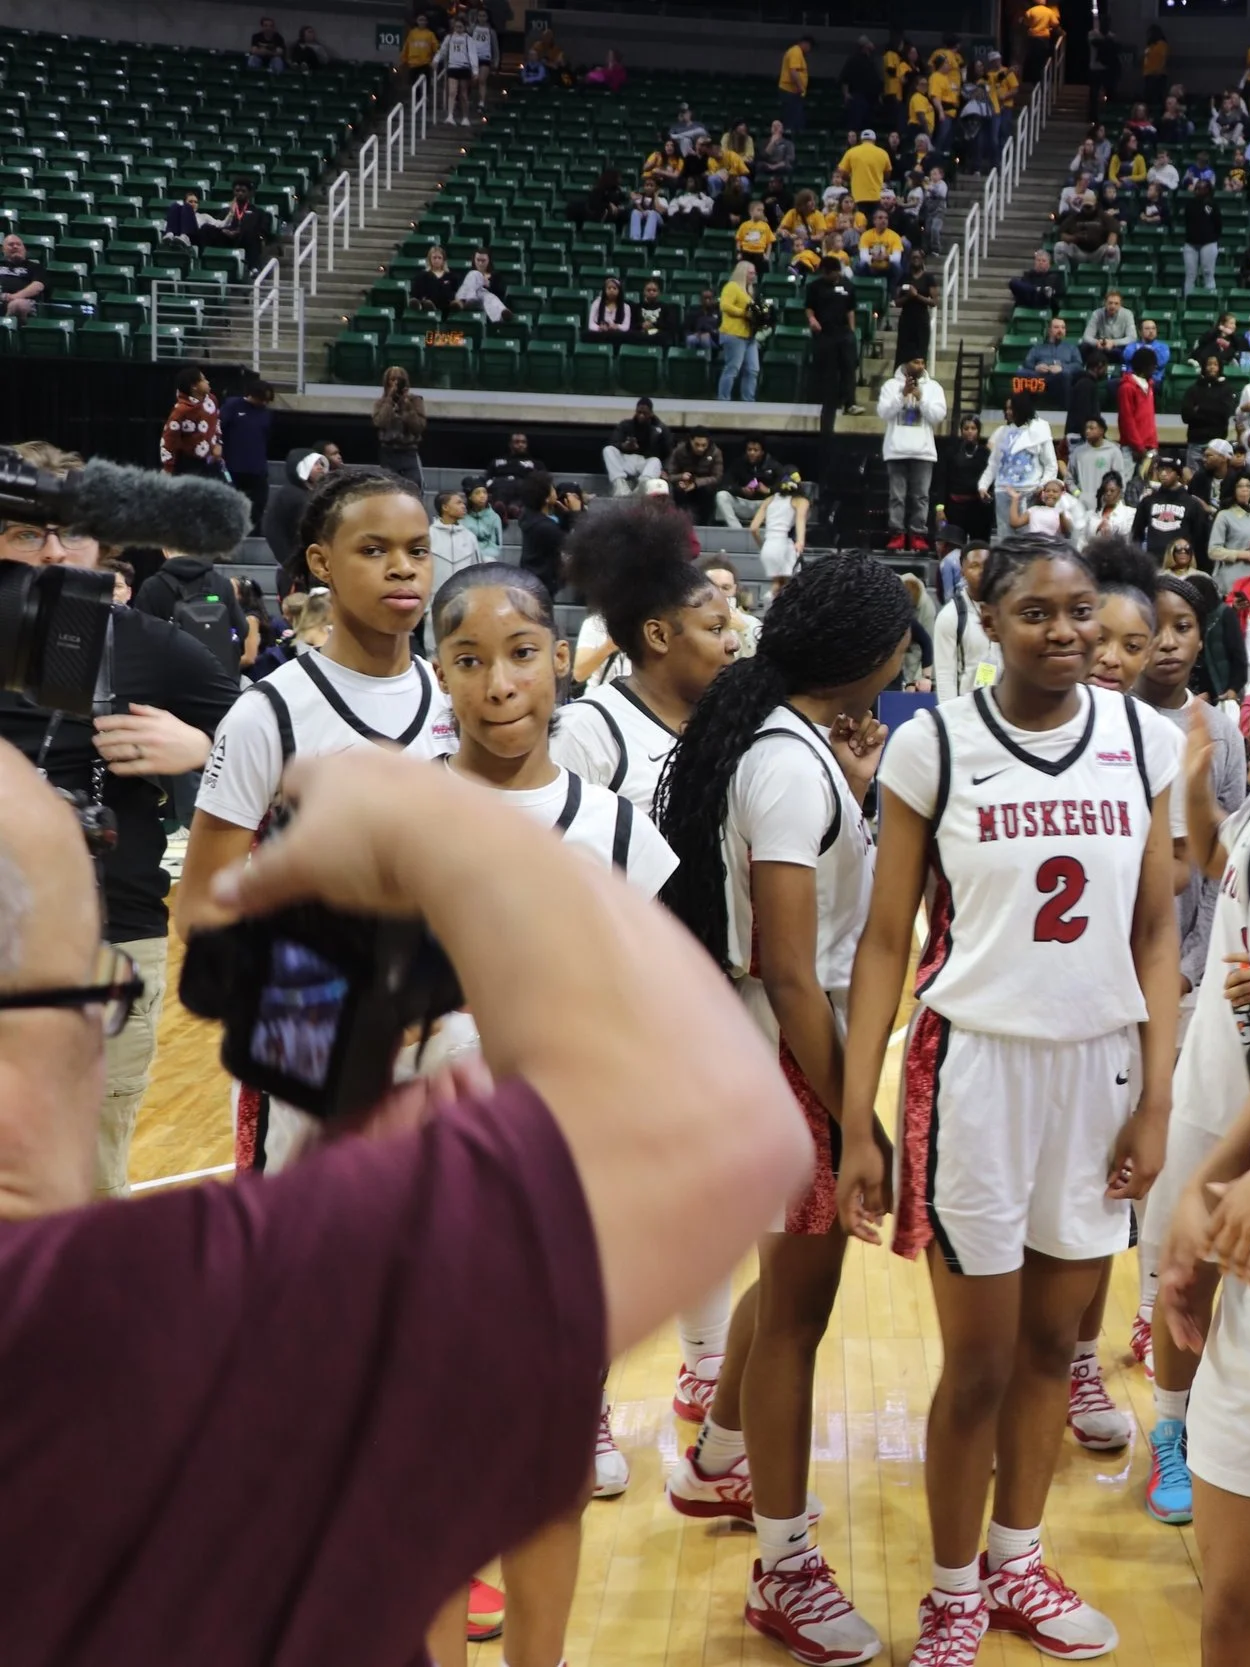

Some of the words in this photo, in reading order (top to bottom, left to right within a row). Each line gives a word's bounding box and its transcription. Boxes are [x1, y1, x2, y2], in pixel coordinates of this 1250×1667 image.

[378, 33, 400, 45] 101
[976, 799, 1133, 842] MUSKEGON
[1033, 854, 1090, 944] 2
